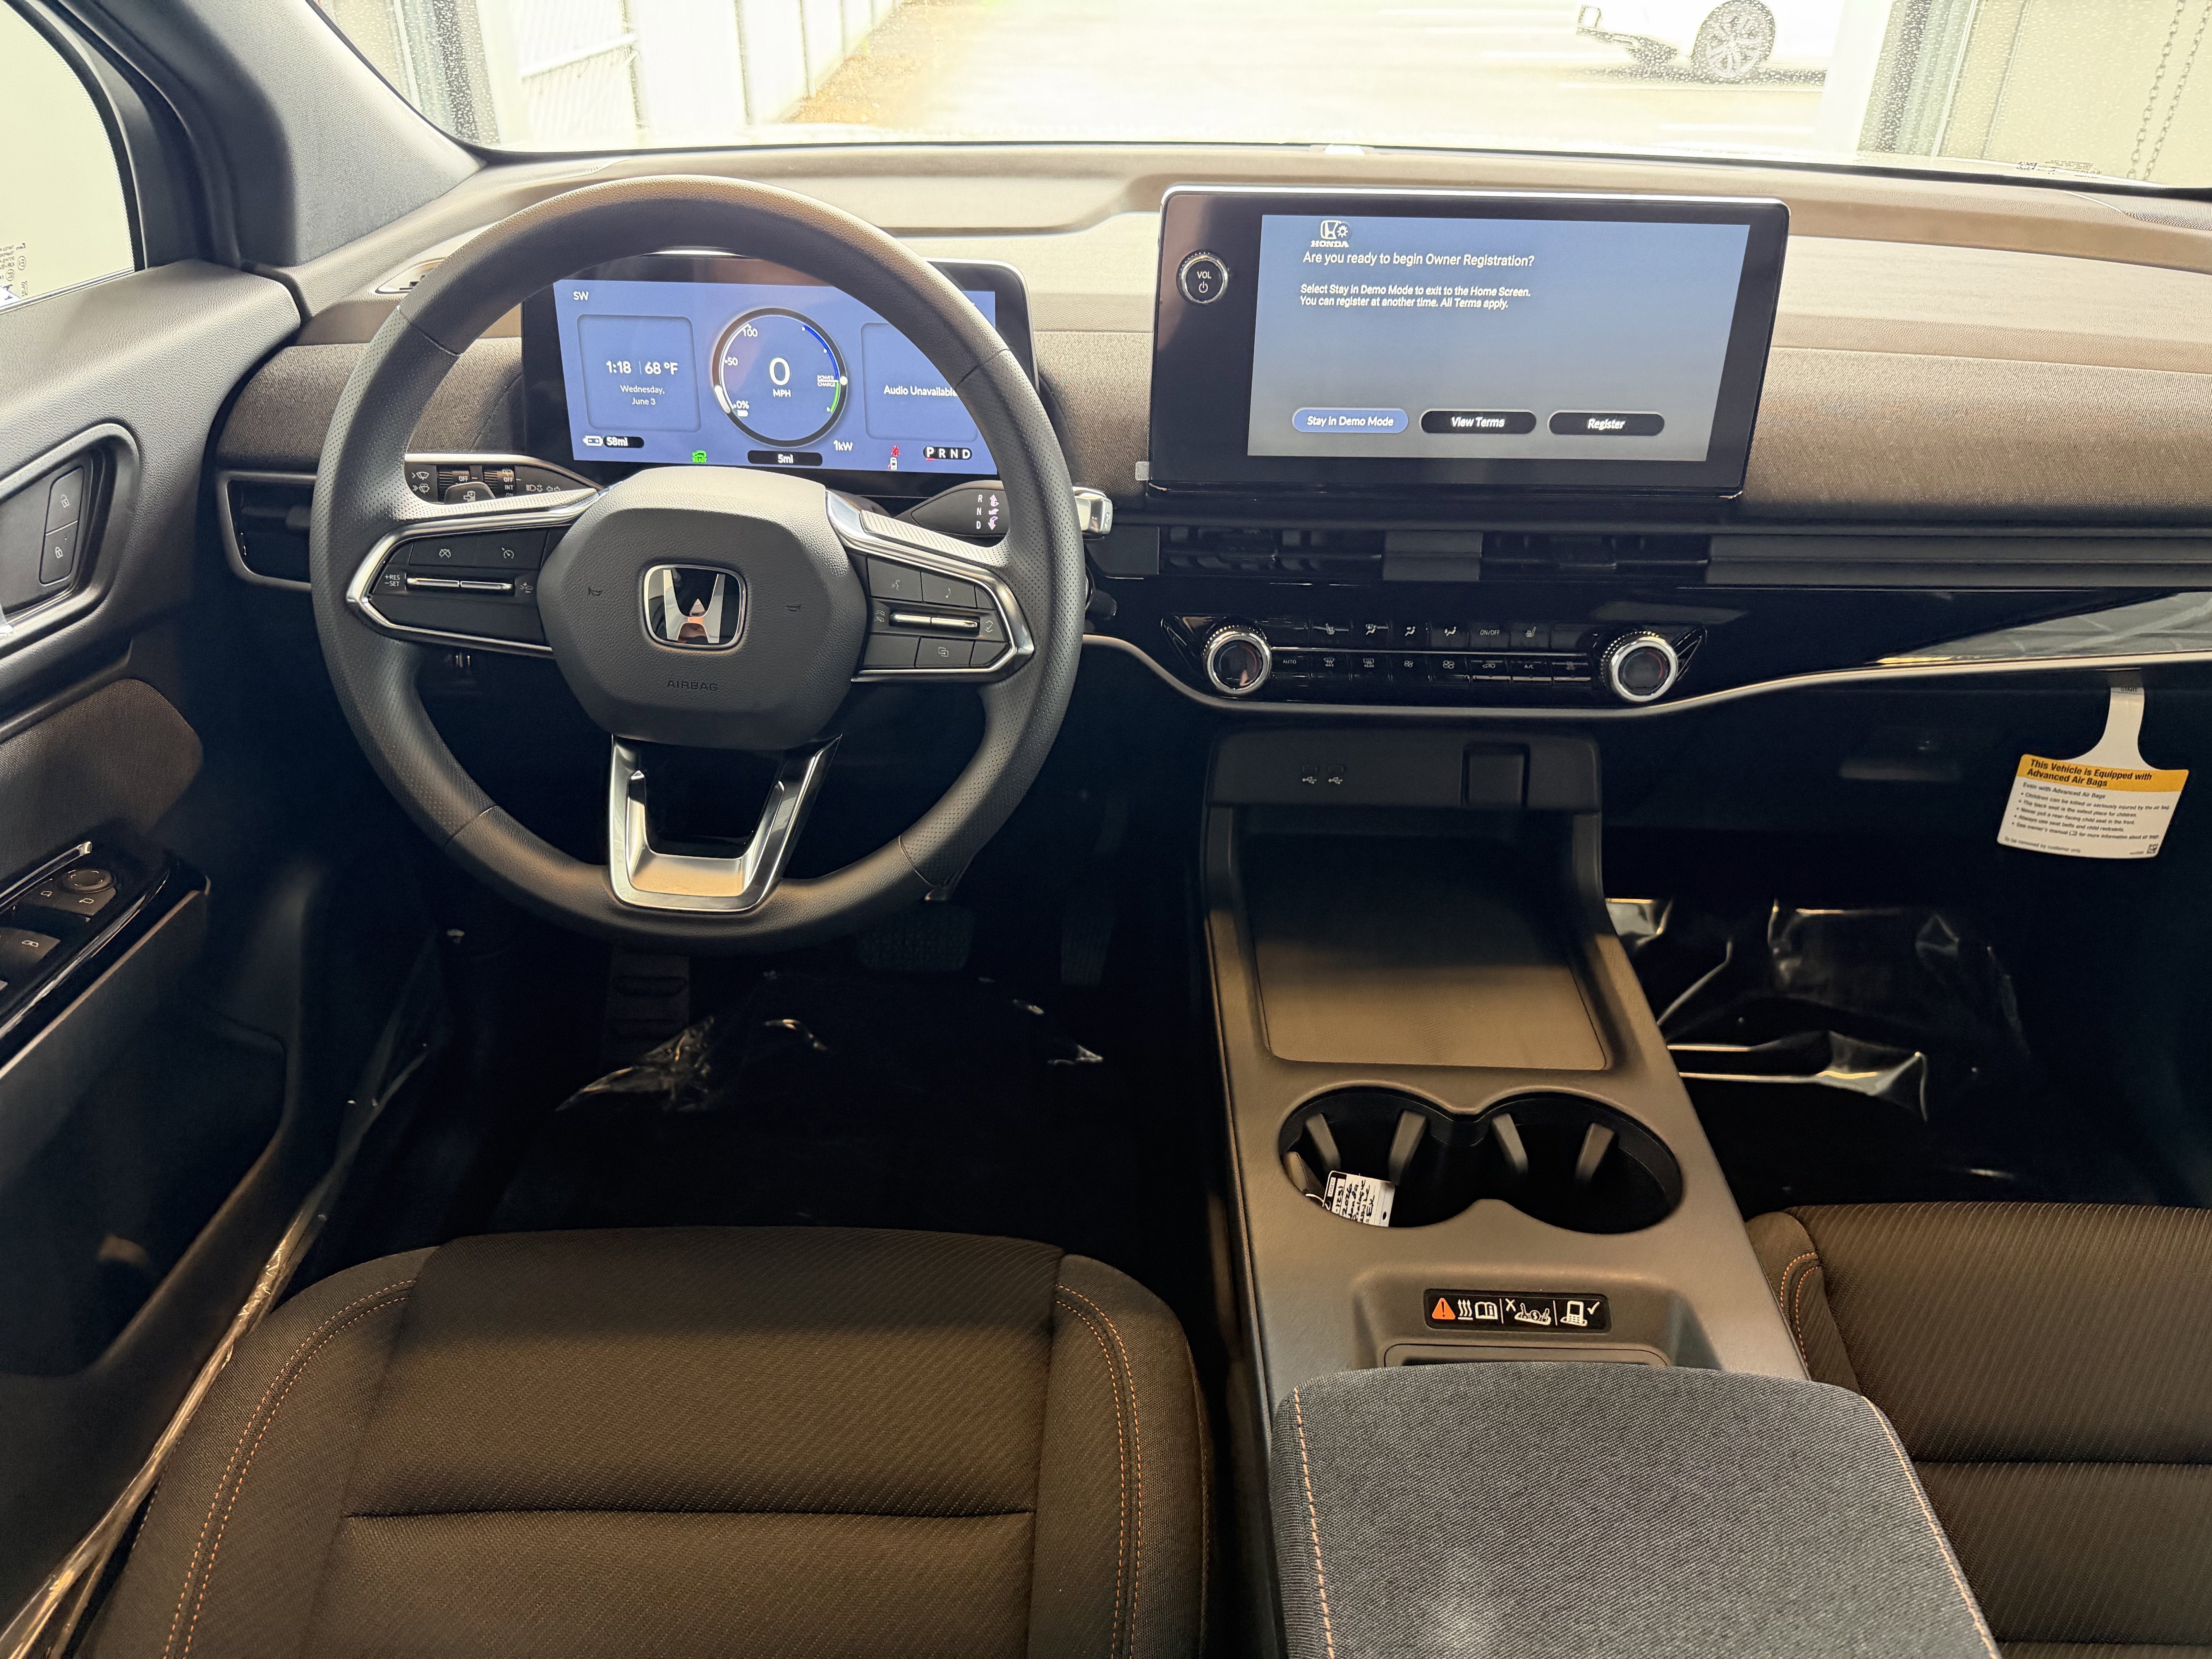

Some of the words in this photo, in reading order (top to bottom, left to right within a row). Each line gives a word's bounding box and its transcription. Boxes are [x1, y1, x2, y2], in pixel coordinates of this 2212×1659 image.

[1303, 251, 1322, 263] Are
[1324, 253, 1344, 266] you
[1347, 252, 1377, 266] ready
[1379, 252, 1391, 264] to
[1393, 252, 1423, 267] begin
[1425, 253, 1461, 265] Owner
[1463, 254, 1535, 268] Registration?
[1197, 271, 1211, 279] VOL
[1300, 283, 1328, 294] Select
[1329, 284, 1349, 296] Stay
[1350, 284, 1359, 294] in
[1360, 285, 1386, 295] Demo
[1388, 285, 1413, 295] Mode
[1415, 285, 1424, 295] to
[1425, 285, 1442, 295] exit
[1443, 285, 1453, 295] to
[1454, 285, 1469, 296] the
[1470, 286, 1497, 296] Home
[1498, 287, 1531, 297] Screen.
[573, 291, 589, 301] SW
[1300, 295, 1317, 306] You
[1318, 298, 1334, 306] can
[1336, 296, 1370, 308] register
[1371, 297, 1380, 306] at
[1381, 296, 1415, 307] another
[1417, 297, 1438, 307] time.
[1440, 297, 1453, 307] All
[1454, 298, 1482, 308] Terms
[1483, 298, 1508, 310] apply.
[743, 328, 758, 337] 100
[728, 357, 738, 366] 50
[606, 361, 632, 374] 1:18
[644, 362, 662, 374] 68
[769, 358, 790, 386] 0
[620, 385, 665, 395] Wednesday,
[773, 389, 791, 398] MPH
[884, 385, 908, 395] Audio
[910, 386, 958, 397] Unavailable
[736, 400, 749, 409] 0%
[1307, 416, 1326, 428] Stay
[1328, 416, 1336, 426] in
[1340, 416, 1366, 426] Demo
[1368, 416, 1394, 427] Mode
[1451, 416, 1474, 427] View
[1476, 416, 1505, 428] Terms
[1587, 418, 1626, 431] Register
[606, 436, 629, 447] 58mi
[833, 440, 853, 451] 1kW
[926, 447, 935, 458] P
[938, 448, 946, 458] R
[950, 448, 958, 459] N
[962, 449, 970, 459] D
[778, 454, 794, 464] 5mi
[978, 494, 983, 503] R
[977, 507, 982, 515] N
[976, 520, 981, 529] D
[667, 680, 718, 691] AIRBAG
[2031, 759, 2048, 769] This
[2052, 763, 2082, 774] Vehicle
[2084, 768, 2092, 776] is
[2094, 769, 2133, 780] Equipped
[2135, 772, 2152, 780] with
[2027, 768, 2070, 782] Advanced
[2072, 776, 2085, 784] Air
[2086, 778, 2107, 787] Bags
[2025, 792, 2048, 801] Children
[2052, 787, 2081, 796] Advanced
